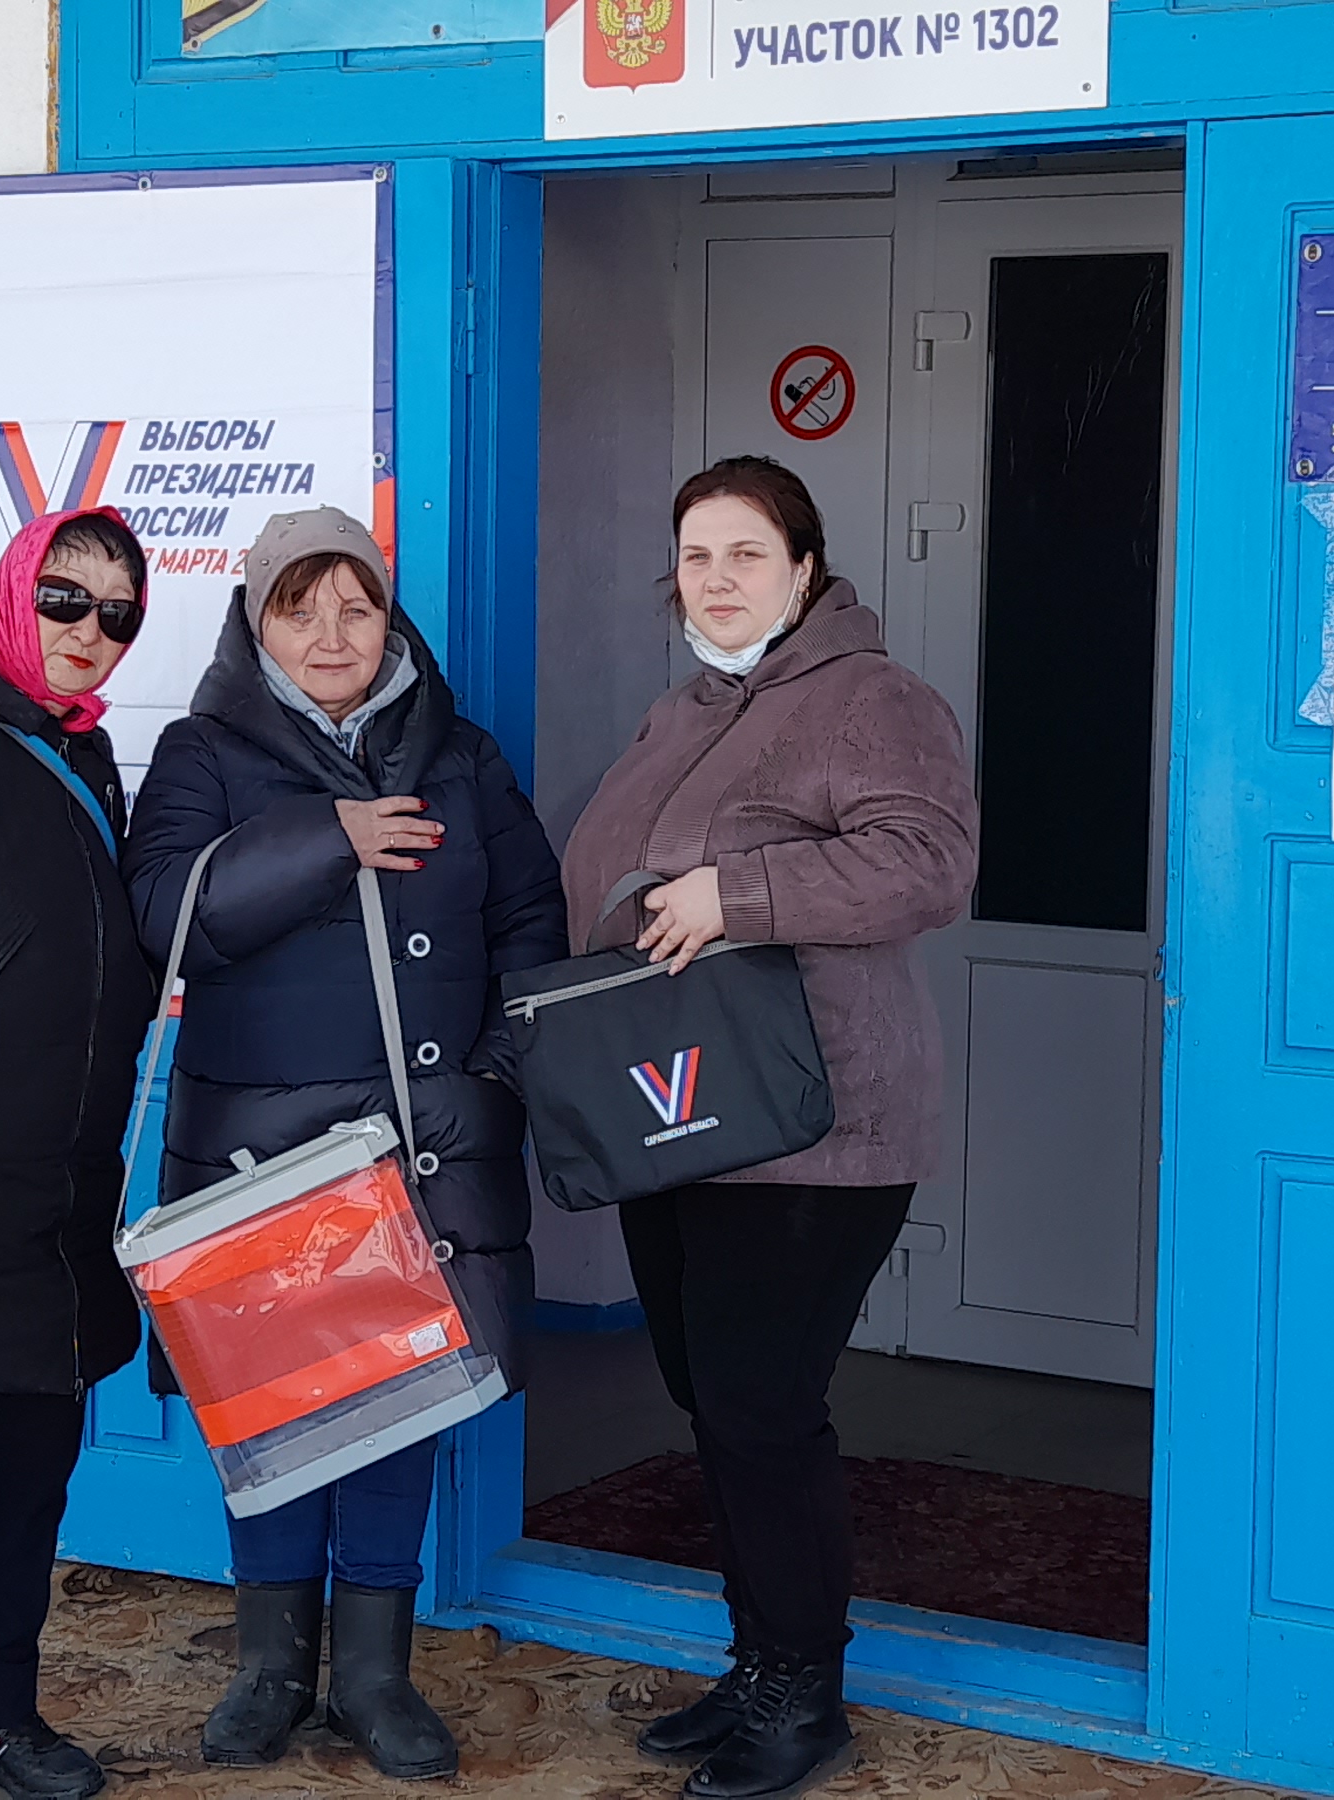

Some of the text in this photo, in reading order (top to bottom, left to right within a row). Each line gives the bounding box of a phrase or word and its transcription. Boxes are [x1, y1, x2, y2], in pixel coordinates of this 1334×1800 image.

[733, 4, 1059, 69] УЧАСТОК № 1302
[139, 420, 275, 451] ВЫБОРЫ
[124, 463, 316, 499] ПРЕЗИДЕНТА
[154, 548, 228, 574] МАРТА
